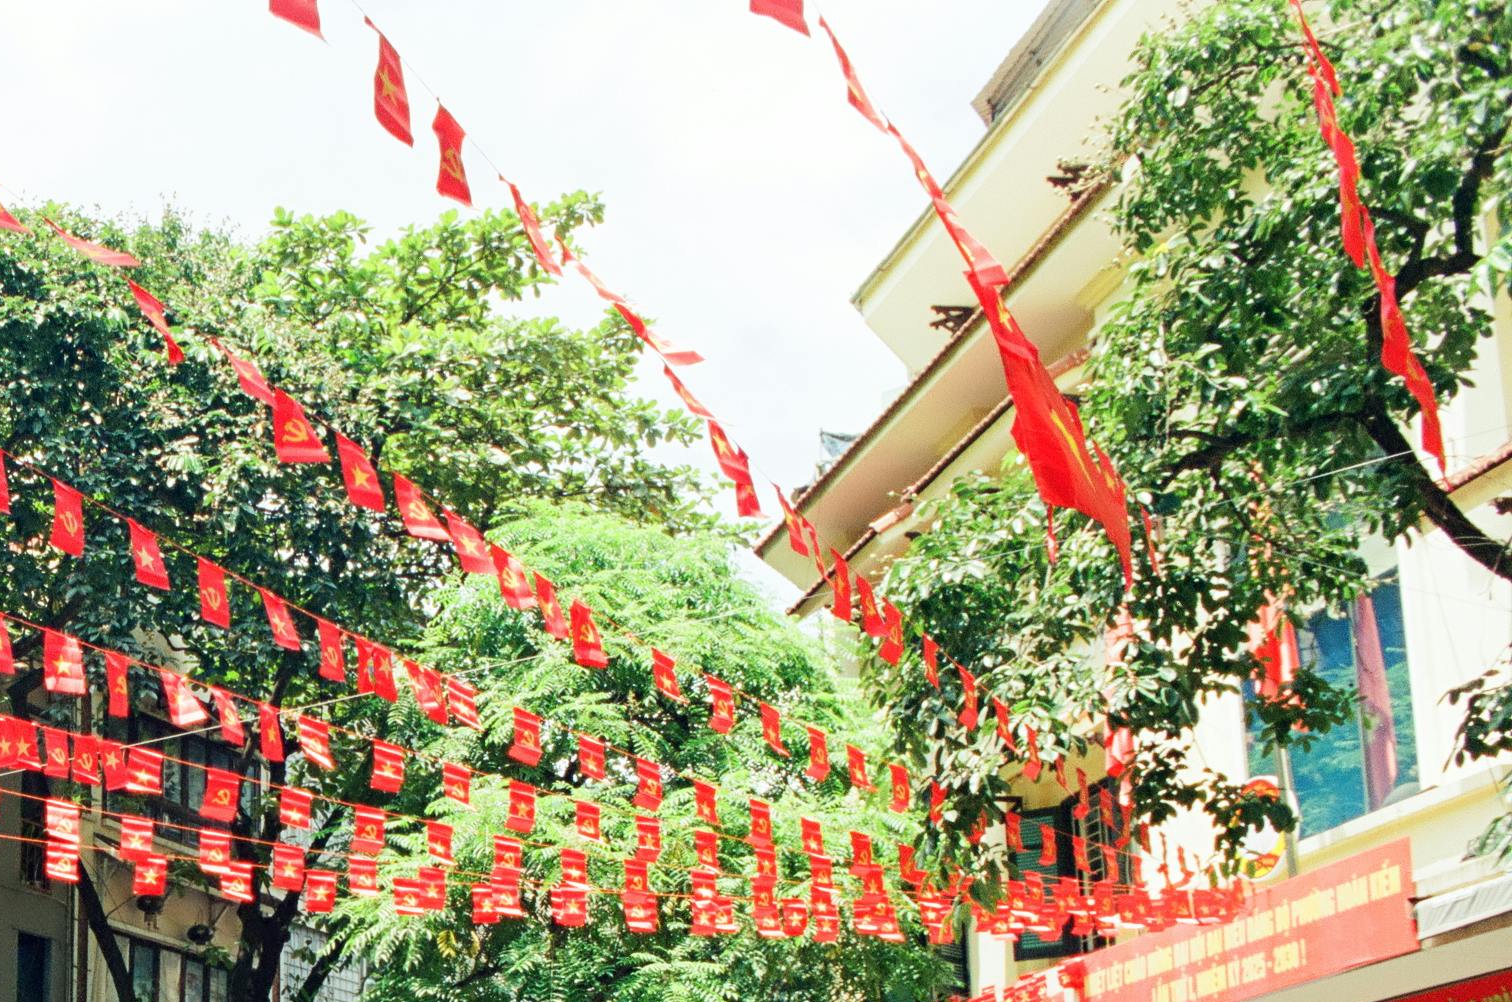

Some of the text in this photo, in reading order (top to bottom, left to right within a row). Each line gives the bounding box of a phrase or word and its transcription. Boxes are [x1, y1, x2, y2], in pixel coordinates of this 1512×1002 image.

[1123, 953, 1146, 985] CHÀO
[1146, 944, 1173, 978] MỪNG
[1274, 899, 1290, 937] BỘ
[1291, 887, 1336, 928] PHƯỜNG
[1336, 873, 1369, 913] HOÀN
[1369, 860, 1402, 901] KIẾM
[1227, 954, 1241, 988] KỲ
[1241, 952, 1267, 984] 2025
[1273, 940, 1301, 974] 2030
